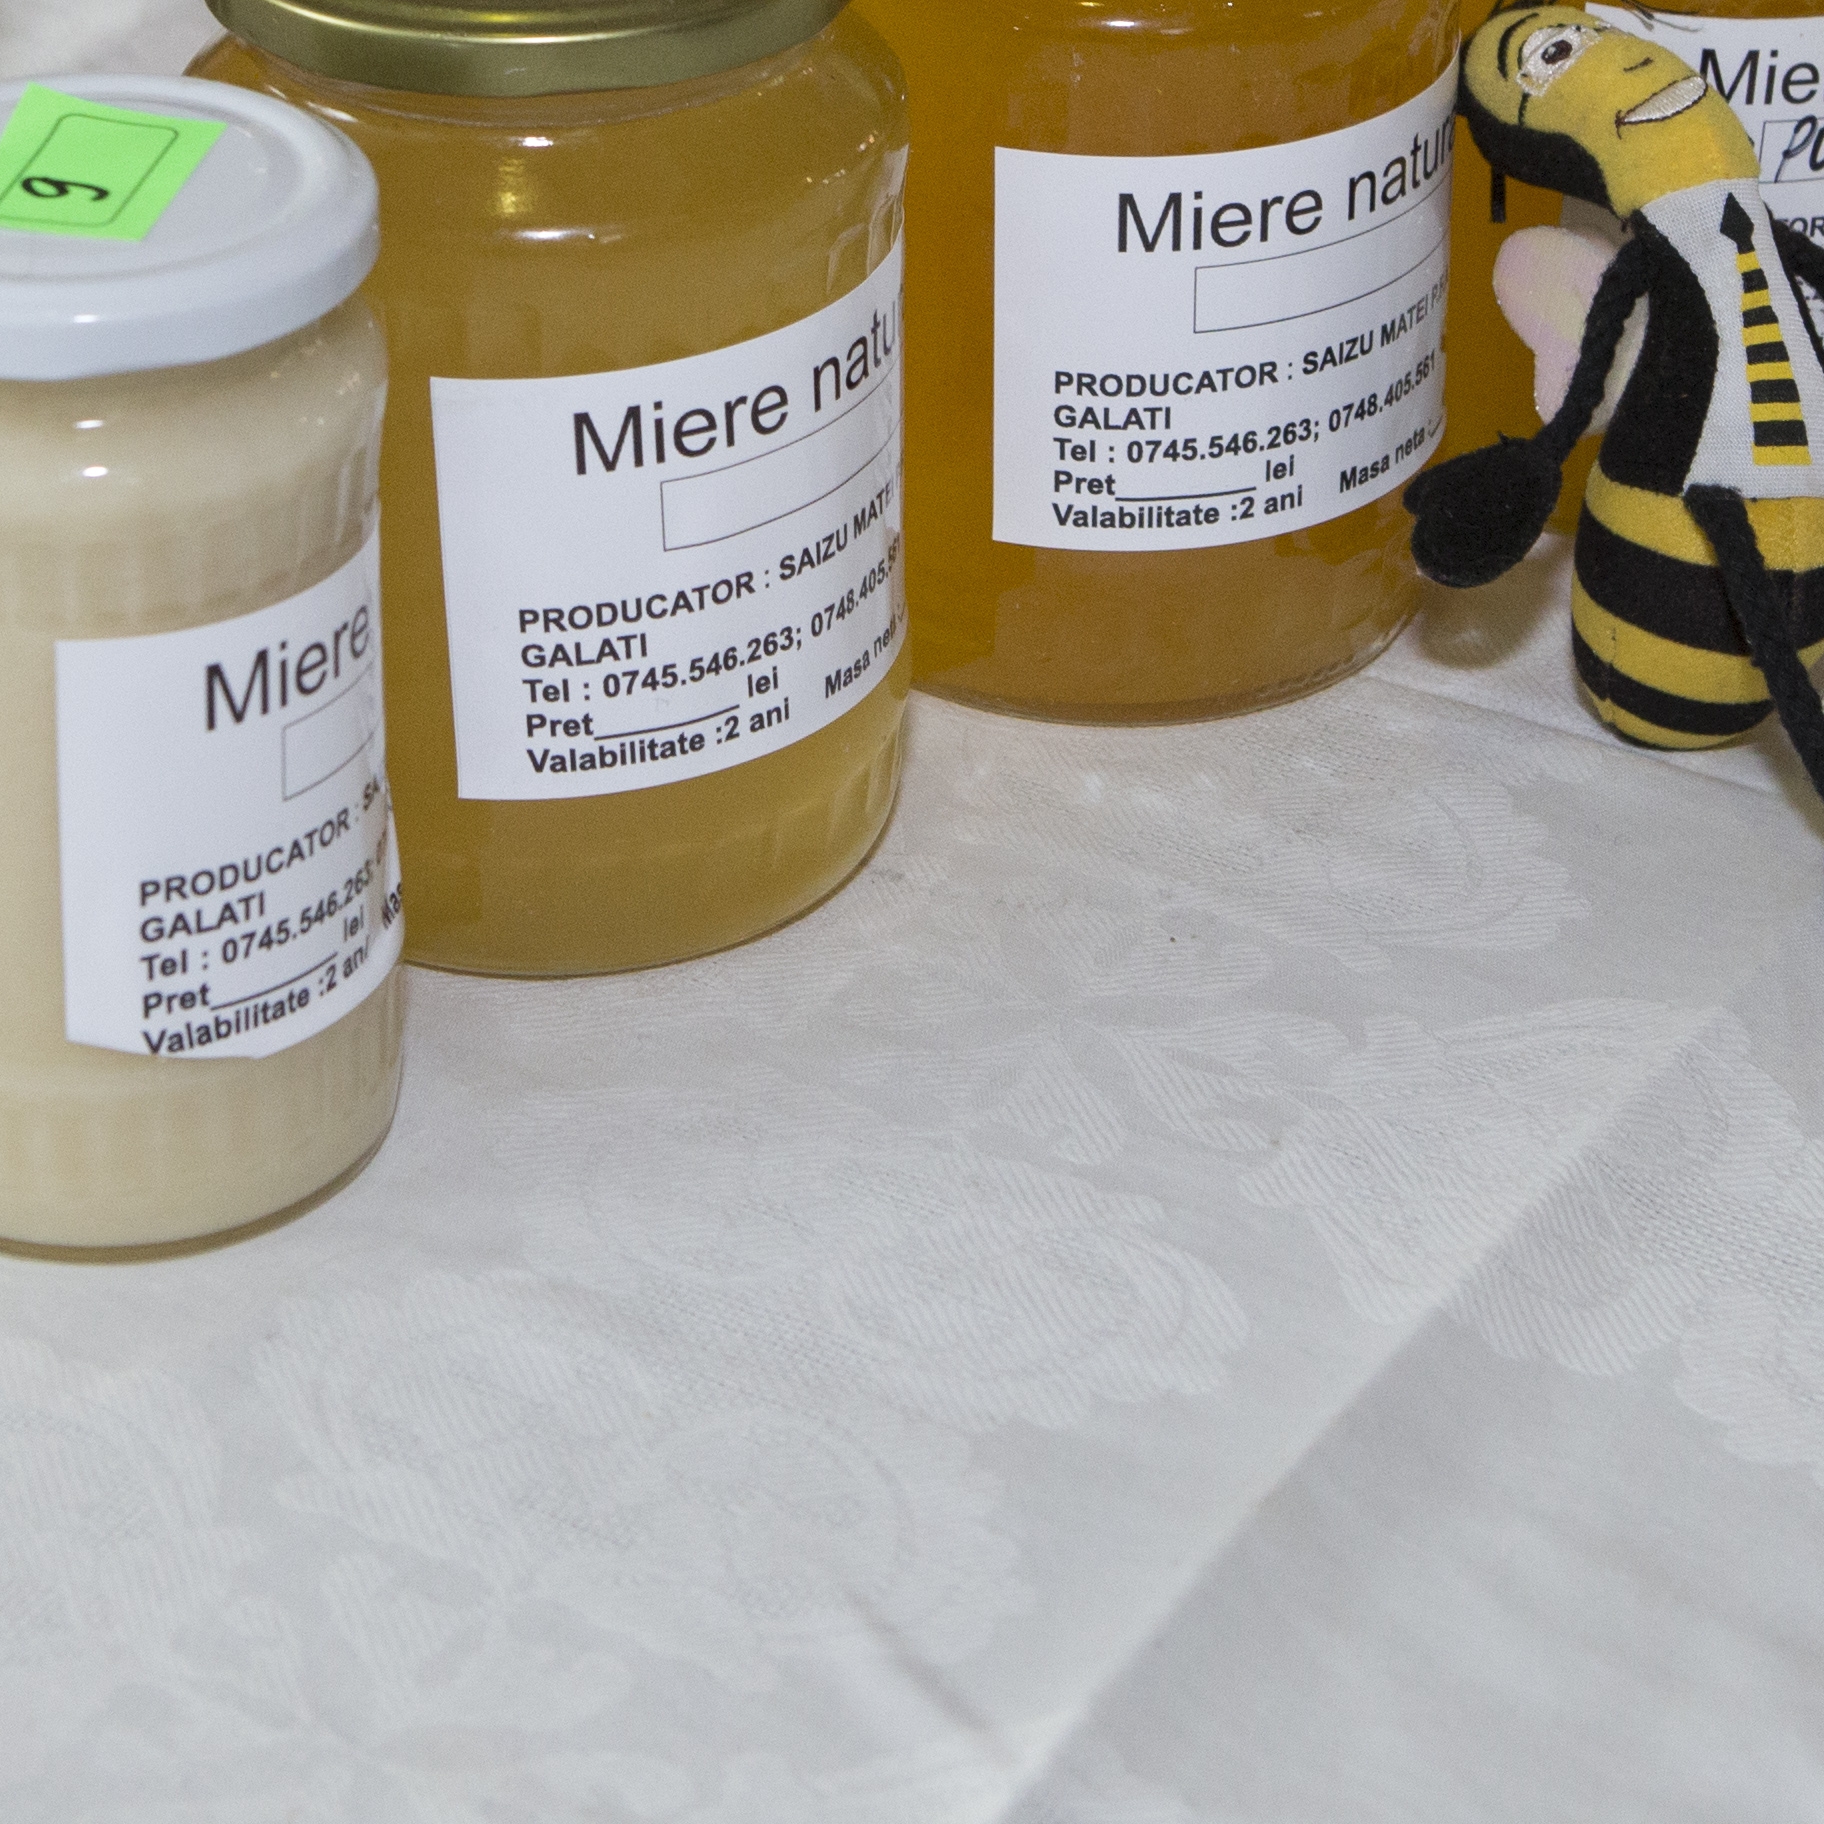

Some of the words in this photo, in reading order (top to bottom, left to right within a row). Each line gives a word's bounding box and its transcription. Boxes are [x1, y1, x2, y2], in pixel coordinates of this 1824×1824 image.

[1116, 188, 1324, 254] Miere
[1054, 361, 1278, 397] PRODUCATOR
[1302, 329, 1374, 375] SAIZU
[1380, 292, 1429, 348] MATEI
[573, 384, 788, 475] Miere
[813, 288, 901, 412] natu
[1053, 405, 1172, 430] GALATI
[1053, 437, 1096, 462] Tel
[1127, 418, 1320, 463] 0745.546.263;
[1052, 503, 1220, 529] Valabilitate
[1264, 484, 1303, 515] ani
[1339, 454, 1390, 493] Masa
[1265, 454, 1295, 482] lei
[518, 570, 755, 633] PRODUCATOR
[779, 523, 848, 581] SAIZU
[205, 604, 371, 731] Miere
[521, 633, 648, 668] GALATI
[522, 678, 570, 703] Tel
[603, 625, 802, 699] 0745.546.263;
[747, 665, 779, 698] lei
[527, 732, 705, 774] Valabilitate
[749, 696, 790, 733] ani
[825, 649, 870, 699] Masa
[139, 807, 351, 906] PRODUCATOR
[139, 890, 265, 943] GALATI
[140, 948, 187, 980] Tel
[143, 986, 310, 1054] Valabilitate
